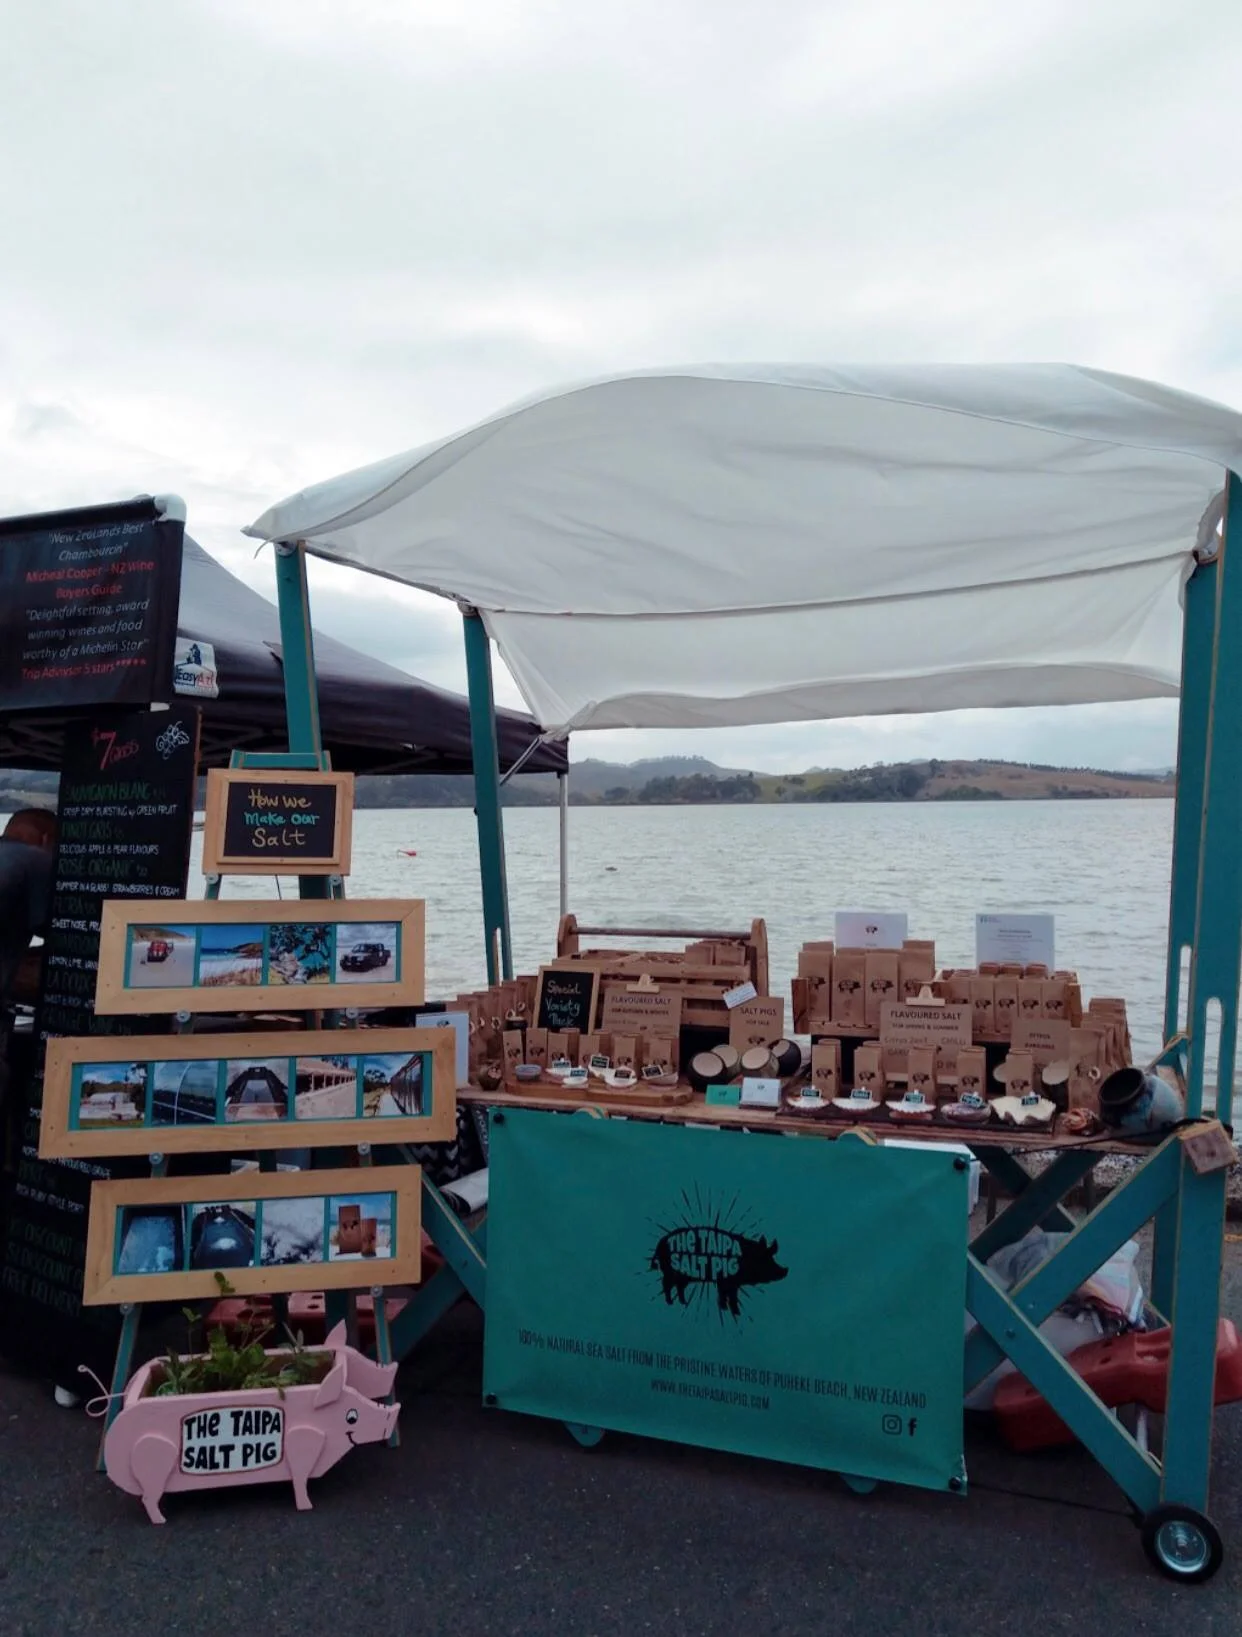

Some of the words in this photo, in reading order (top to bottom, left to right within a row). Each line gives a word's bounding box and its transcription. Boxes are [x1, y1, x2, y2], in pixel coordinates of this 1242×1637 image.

[121, 522, 144, 534] Best
[66, 565, 102, 580] Cooper
[110, 561, 126, 575] NZ
[91, 583, 123, 597] Guide
[115, 598, 150, 612] award
[27, 628, 67, 642] winning
[68, 625, 97, 637] wines
[97, 622, 117, 634] and
[115, 619, 143, 635] food
[22, 645, 58, 661] worthy
[58, 644, 71, 660] of
[79, 642, 119, 656] Michelin
[21, 666, 41, 681] Trip
[248, 788, 279, 809] How
[251, 827, 307, 848] Salt
[544, 995, 581, 1018] Variety
[611, 995, 653, 1005] FLAVOURED
[654, 996, 672, 1005] SALT
[740, 1006, 758, 1015] SALT
[759, 1007, 777, 1017] PIGS
[890, 1010, 940, 1020] FLAVOURED
[941, 1011, 962, 1021] SALT
[698, 1229, 743, 1258] TAIPA
[670, 1252, 708, 1281] SALT
[710, 1255, 740, 1280] PIG
[518, 1327, 545, 1349] 100%
[546, 1334, 585, 1357] NATURAL
[585, 1340, 604, 1359] SEA
[604, 1344, 627, 1363] SALT
[627, 1348, 654, 1368] FROM
[655, 1352, 672, 1371] THE
[673, 1355, 717, 1378] PRISTINE
[718, 1361, 758, 1384] WATERS
[758, 1368, 774, 1387] OF
[773, 1371, 811, 1394] PUHEKE
[853, 1382, 878, 1404] NEW
[879, 1386, 927, 1410] ZEALAND
[230, 1409, 281, 1437] TAIPA
[183, 1443, 236, 1471] SALT
[242, 1440, 278, 1468] PIG
